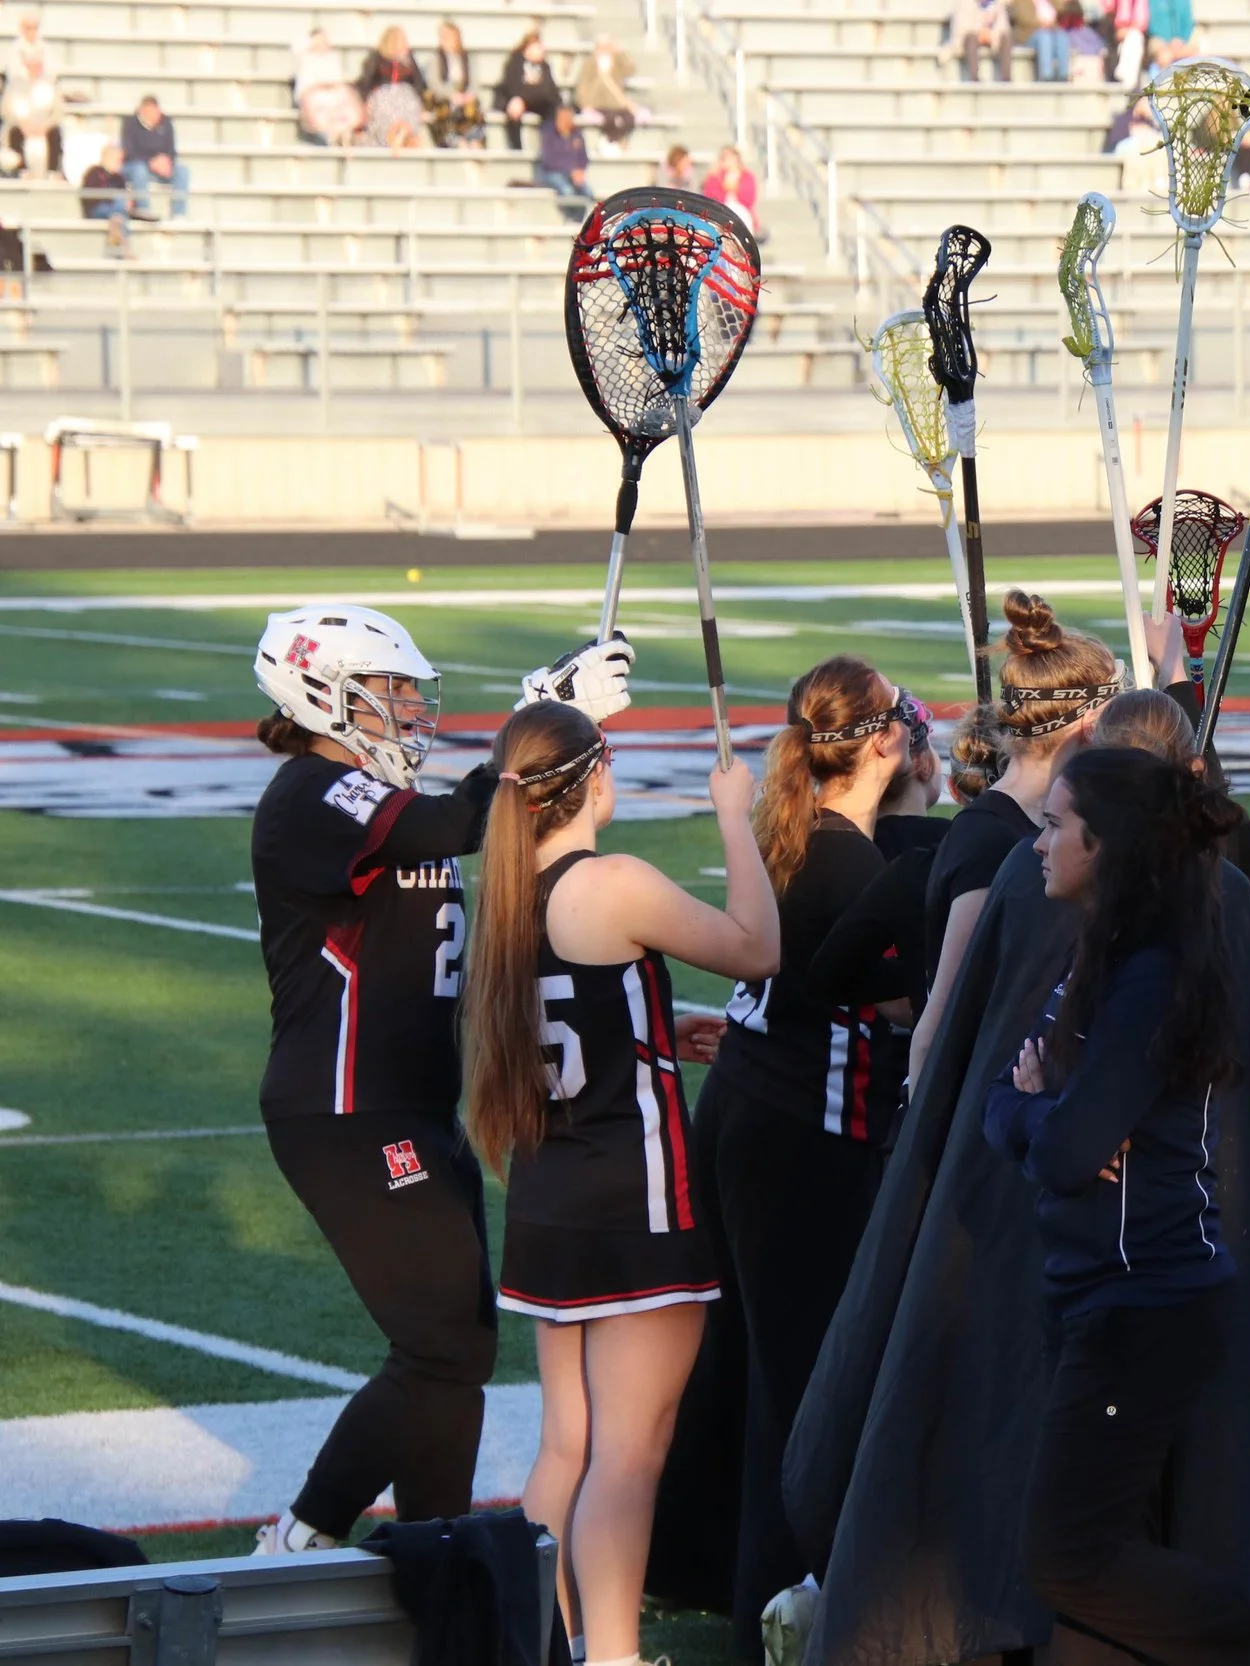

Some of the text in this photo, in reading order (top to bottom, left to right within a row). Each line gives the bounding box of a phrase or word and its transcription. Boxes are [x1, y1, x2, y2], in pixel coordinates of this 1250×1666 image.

[1053, 688, 1088, 699] STX
[811, 721, 885, 743] STX STX
[1031, 716, 1067, 736] STX
[388, 1170, 429, 1190] LACROSSE
